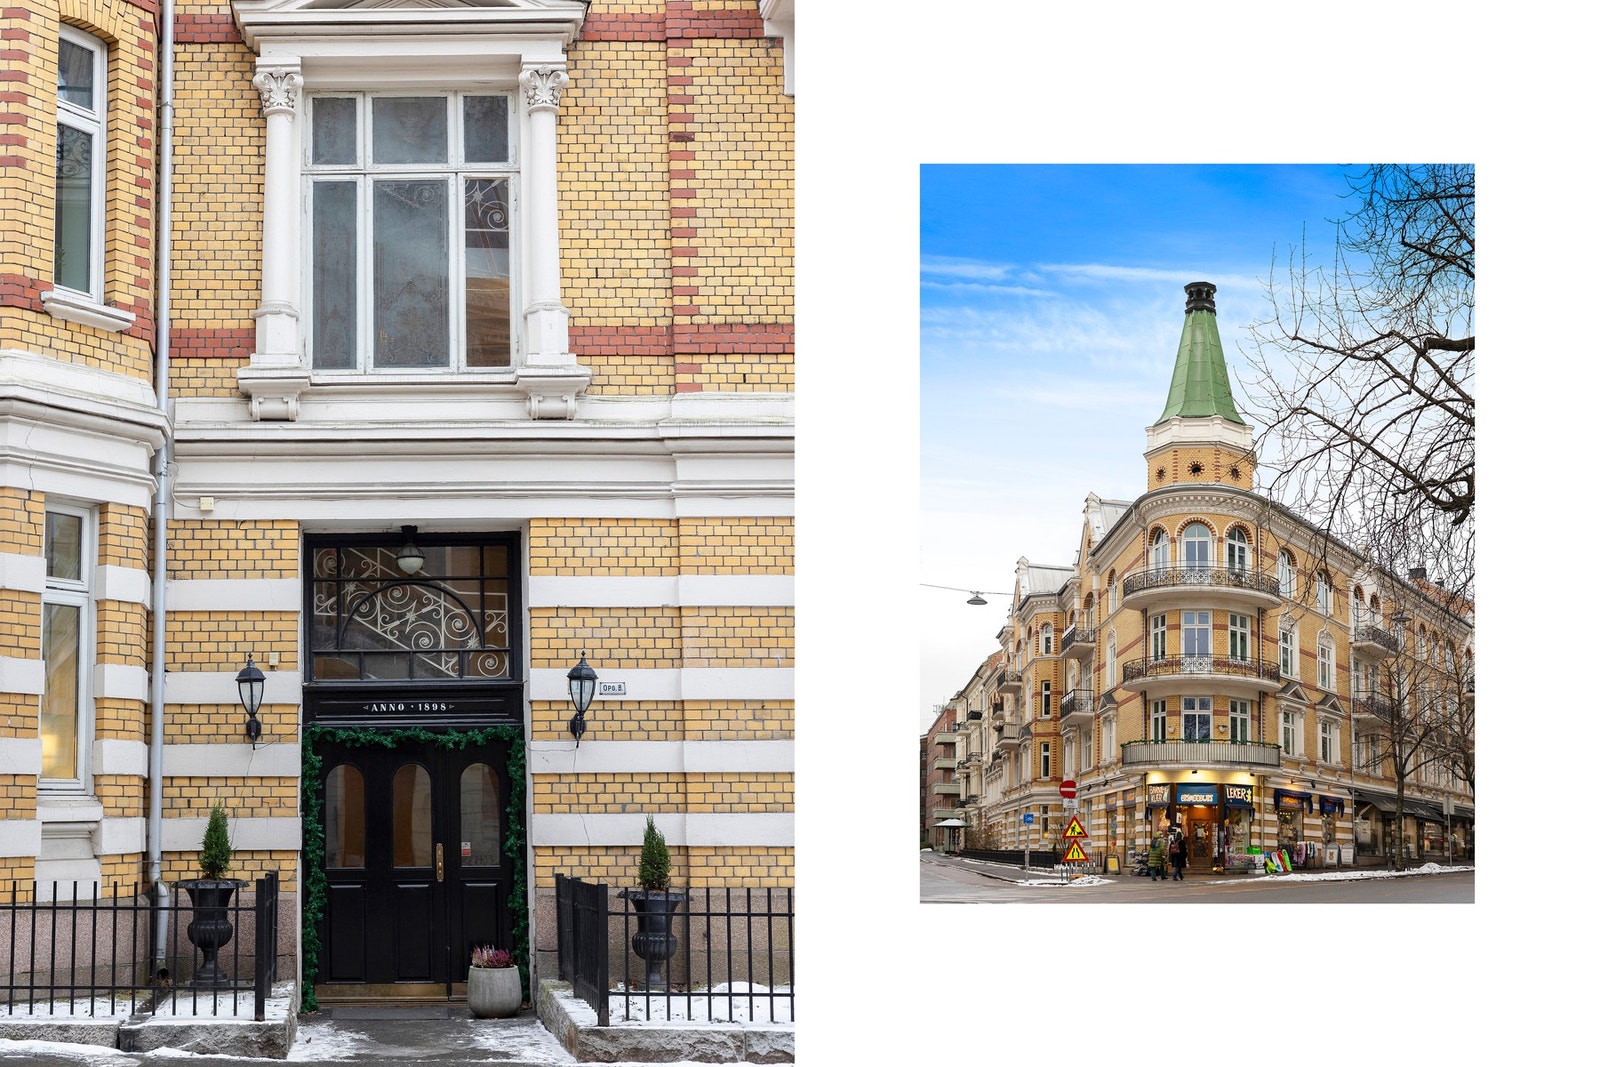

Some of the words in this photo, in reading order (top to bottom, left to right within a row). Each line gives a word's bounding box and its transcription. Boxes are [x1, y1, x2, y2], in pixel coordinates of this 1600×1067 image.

[371, 703, 405, 712] ANNO
[418, 702, 447, 711] 1898
[1226, 787, 1246, 800] LEKER
